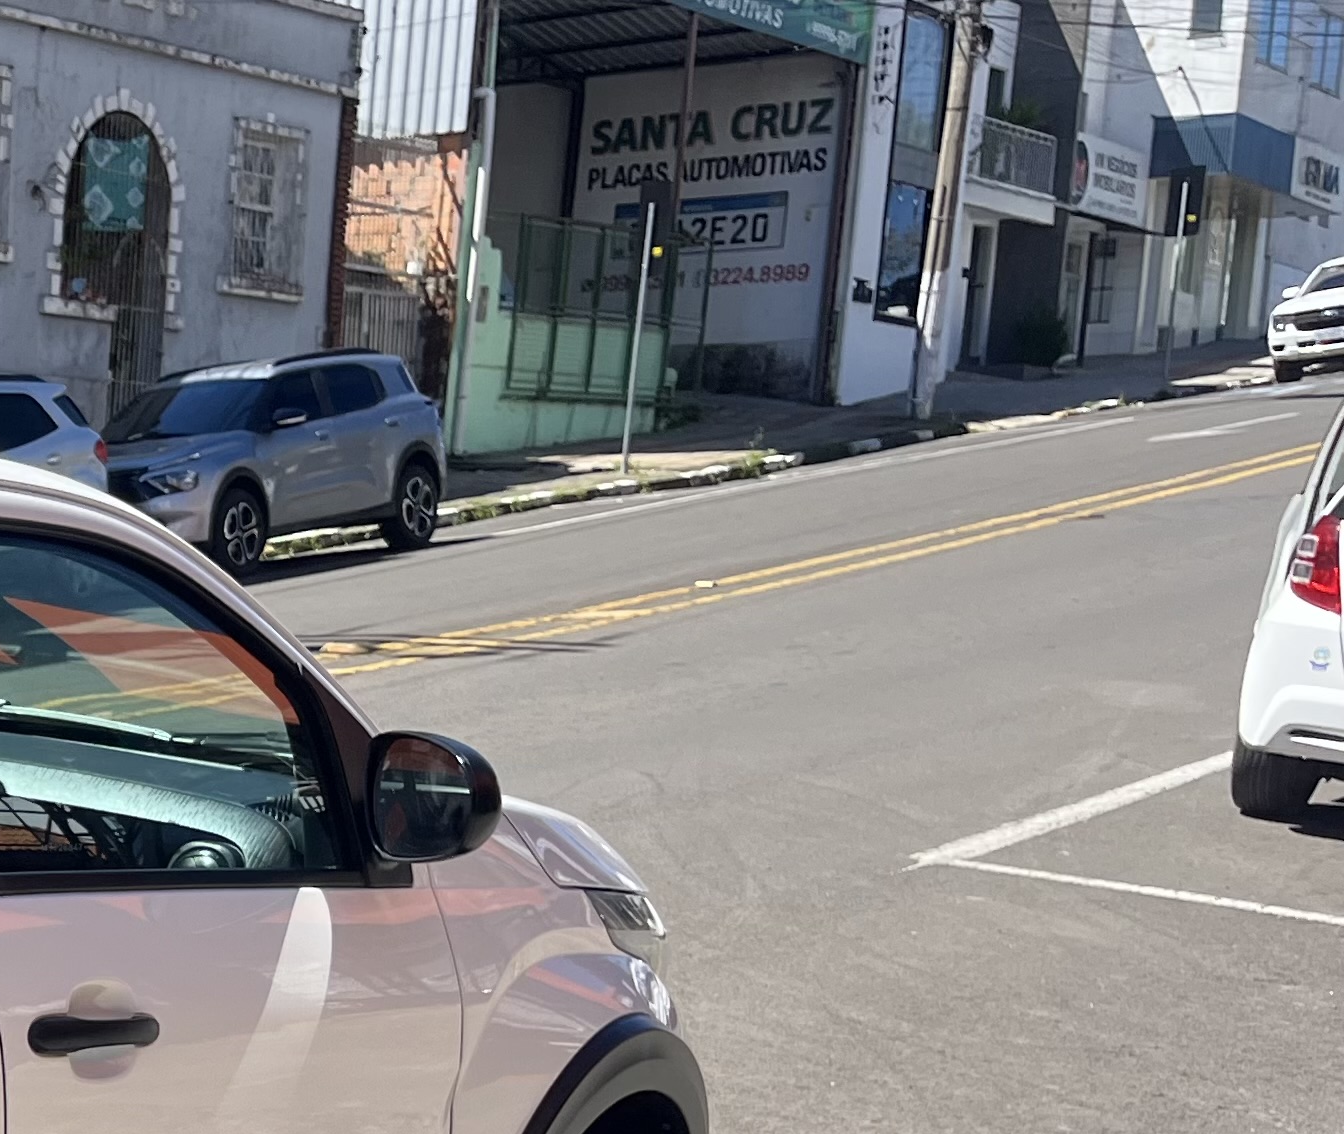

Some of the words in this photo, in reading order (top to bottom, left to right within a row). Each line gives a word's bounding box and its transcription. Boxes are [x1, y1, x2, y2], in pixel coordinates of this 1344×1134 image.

[590, 109, 715, 155] SANTA
[730, 97, 835, 141] CRUZ
[587, 161, 669, 190] PLACAS
